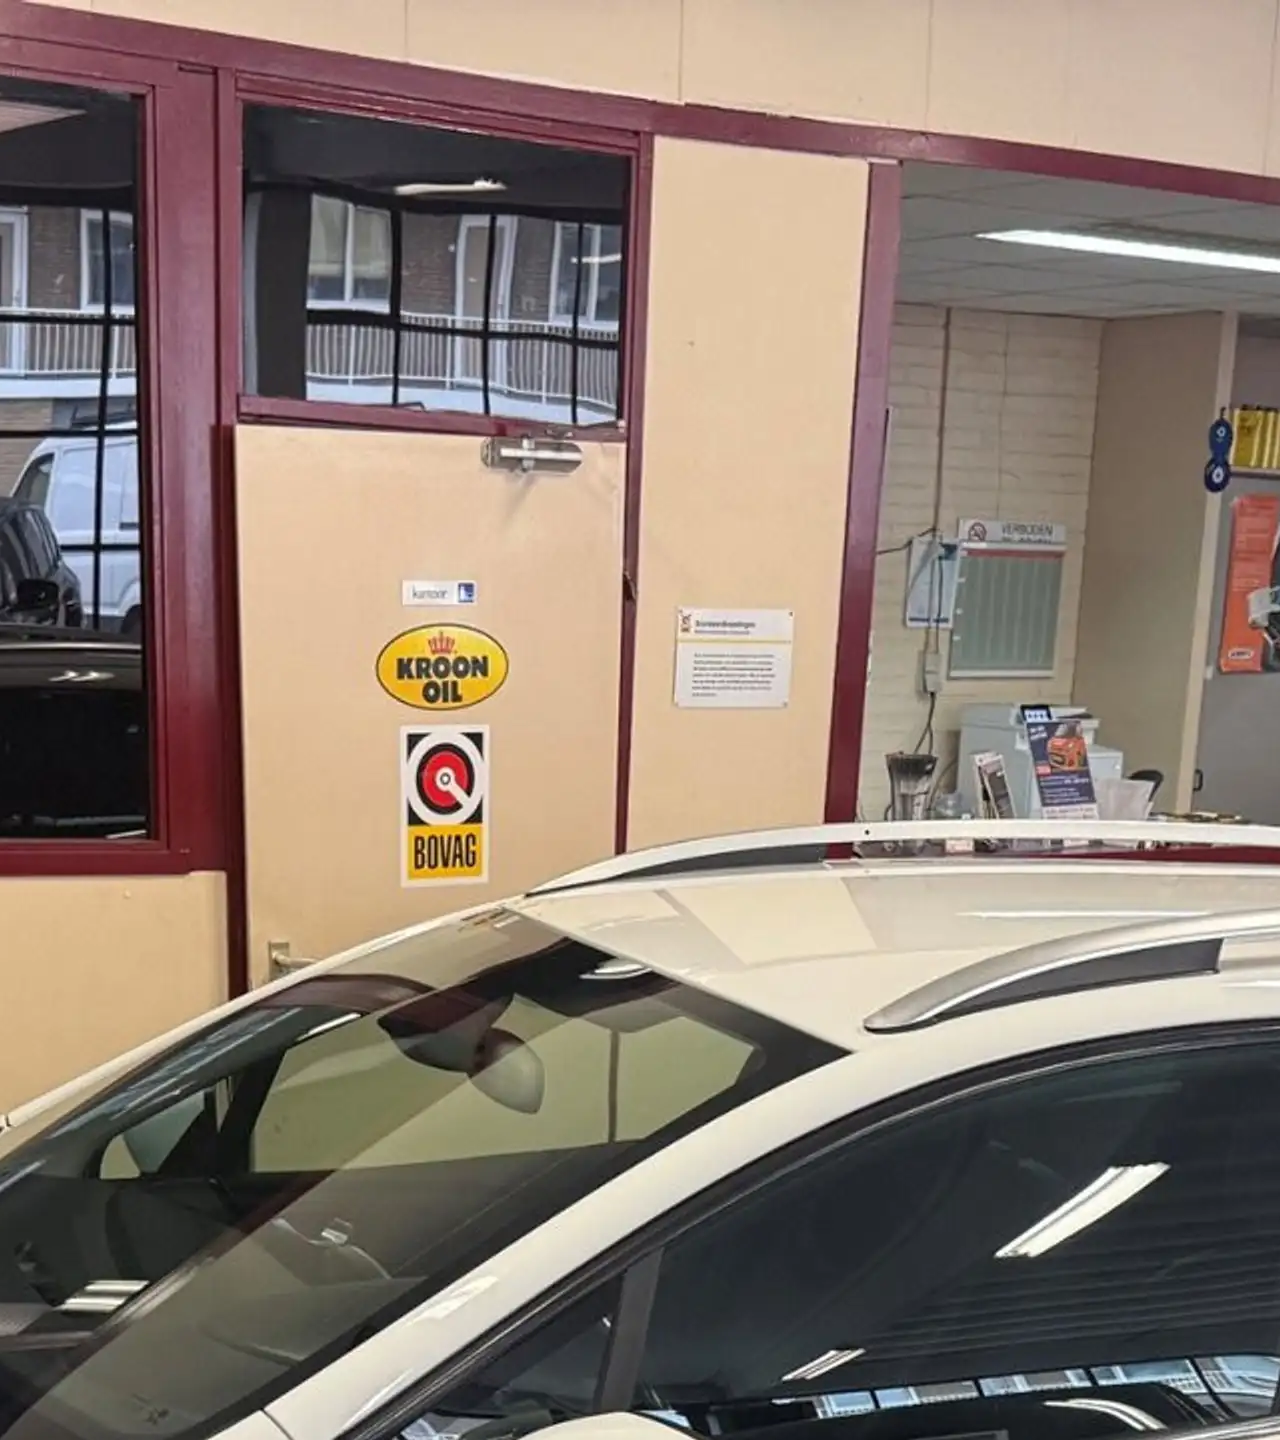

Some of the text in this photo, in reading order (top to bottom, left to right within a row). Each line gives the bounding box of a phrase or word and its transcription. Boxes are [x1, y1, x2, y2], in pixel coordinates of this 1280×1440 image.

[1002, 523, 1053, 537] VERBODEN
[396, 655, 489, 681] KROON
[422, 681, 463, 704] OIL
[413, 834, 477, 870] BOVAG
